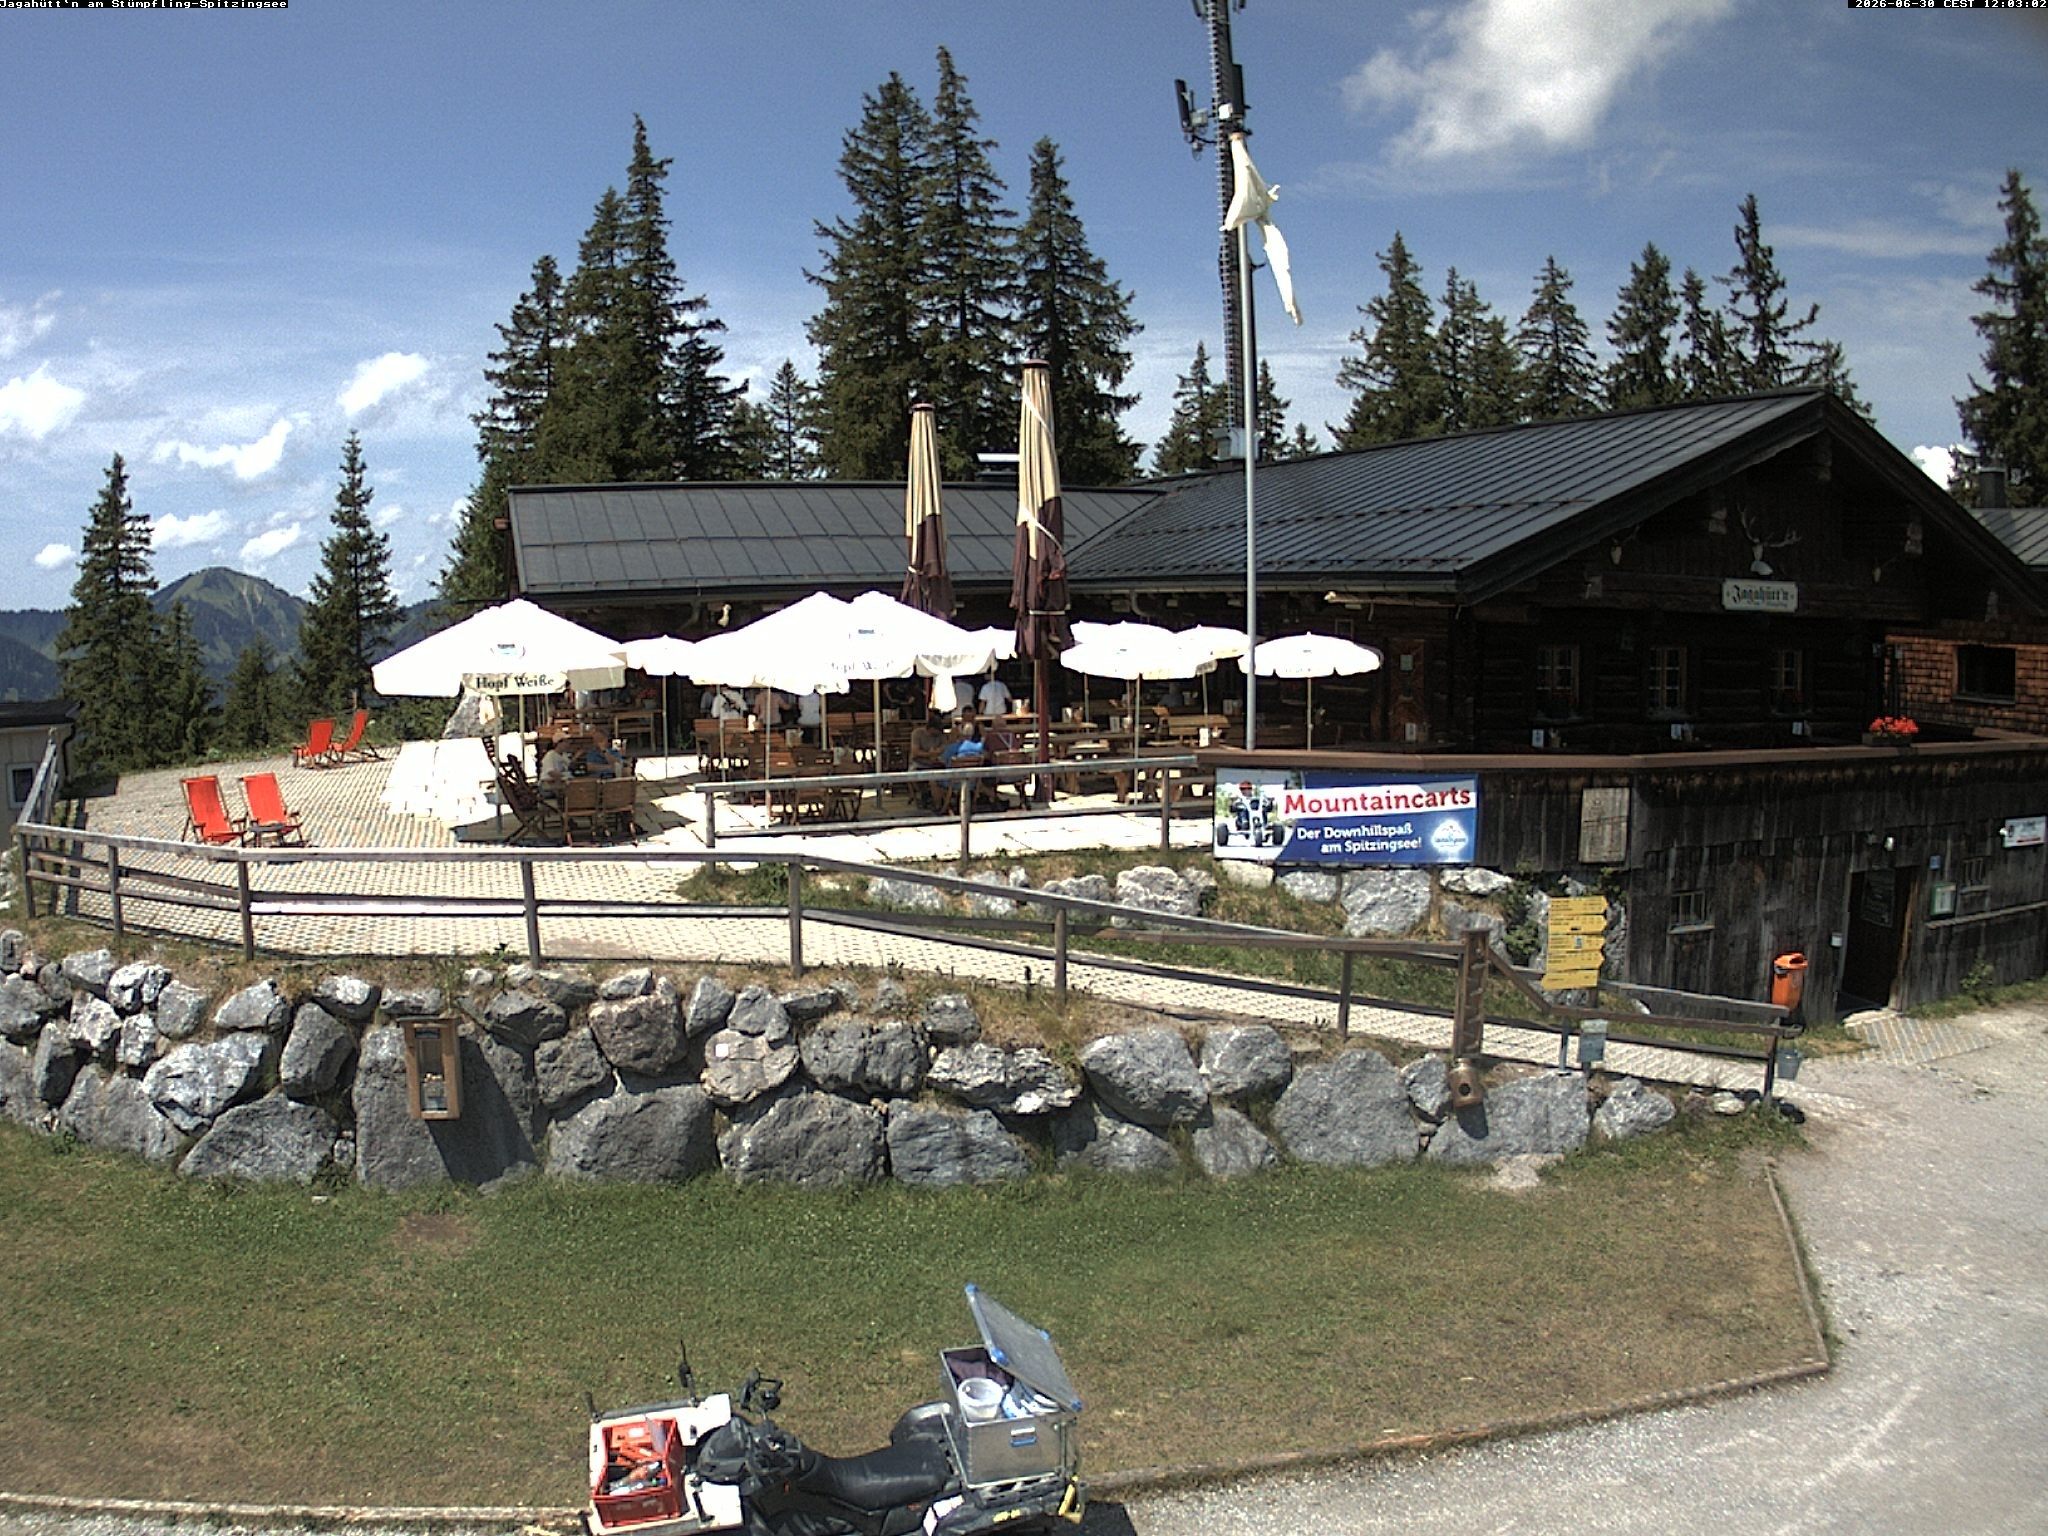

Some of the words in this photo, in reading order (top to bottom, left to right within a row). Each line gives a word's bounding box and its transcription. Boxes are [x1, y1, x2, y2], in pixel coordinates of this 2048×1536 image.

[476, 675, 512, 692] Hopf
[514, 673, 554, 688] Weiße
[1284, 786, 1471, 814] Mountaincarts
[1297, 826, 1321, 840] Der
[1323, 822, 1413, 839] Downhillspaß
[1320, 843, 1342, 854] am
[1344, 837, 1422, 855] Spitzingsee!
